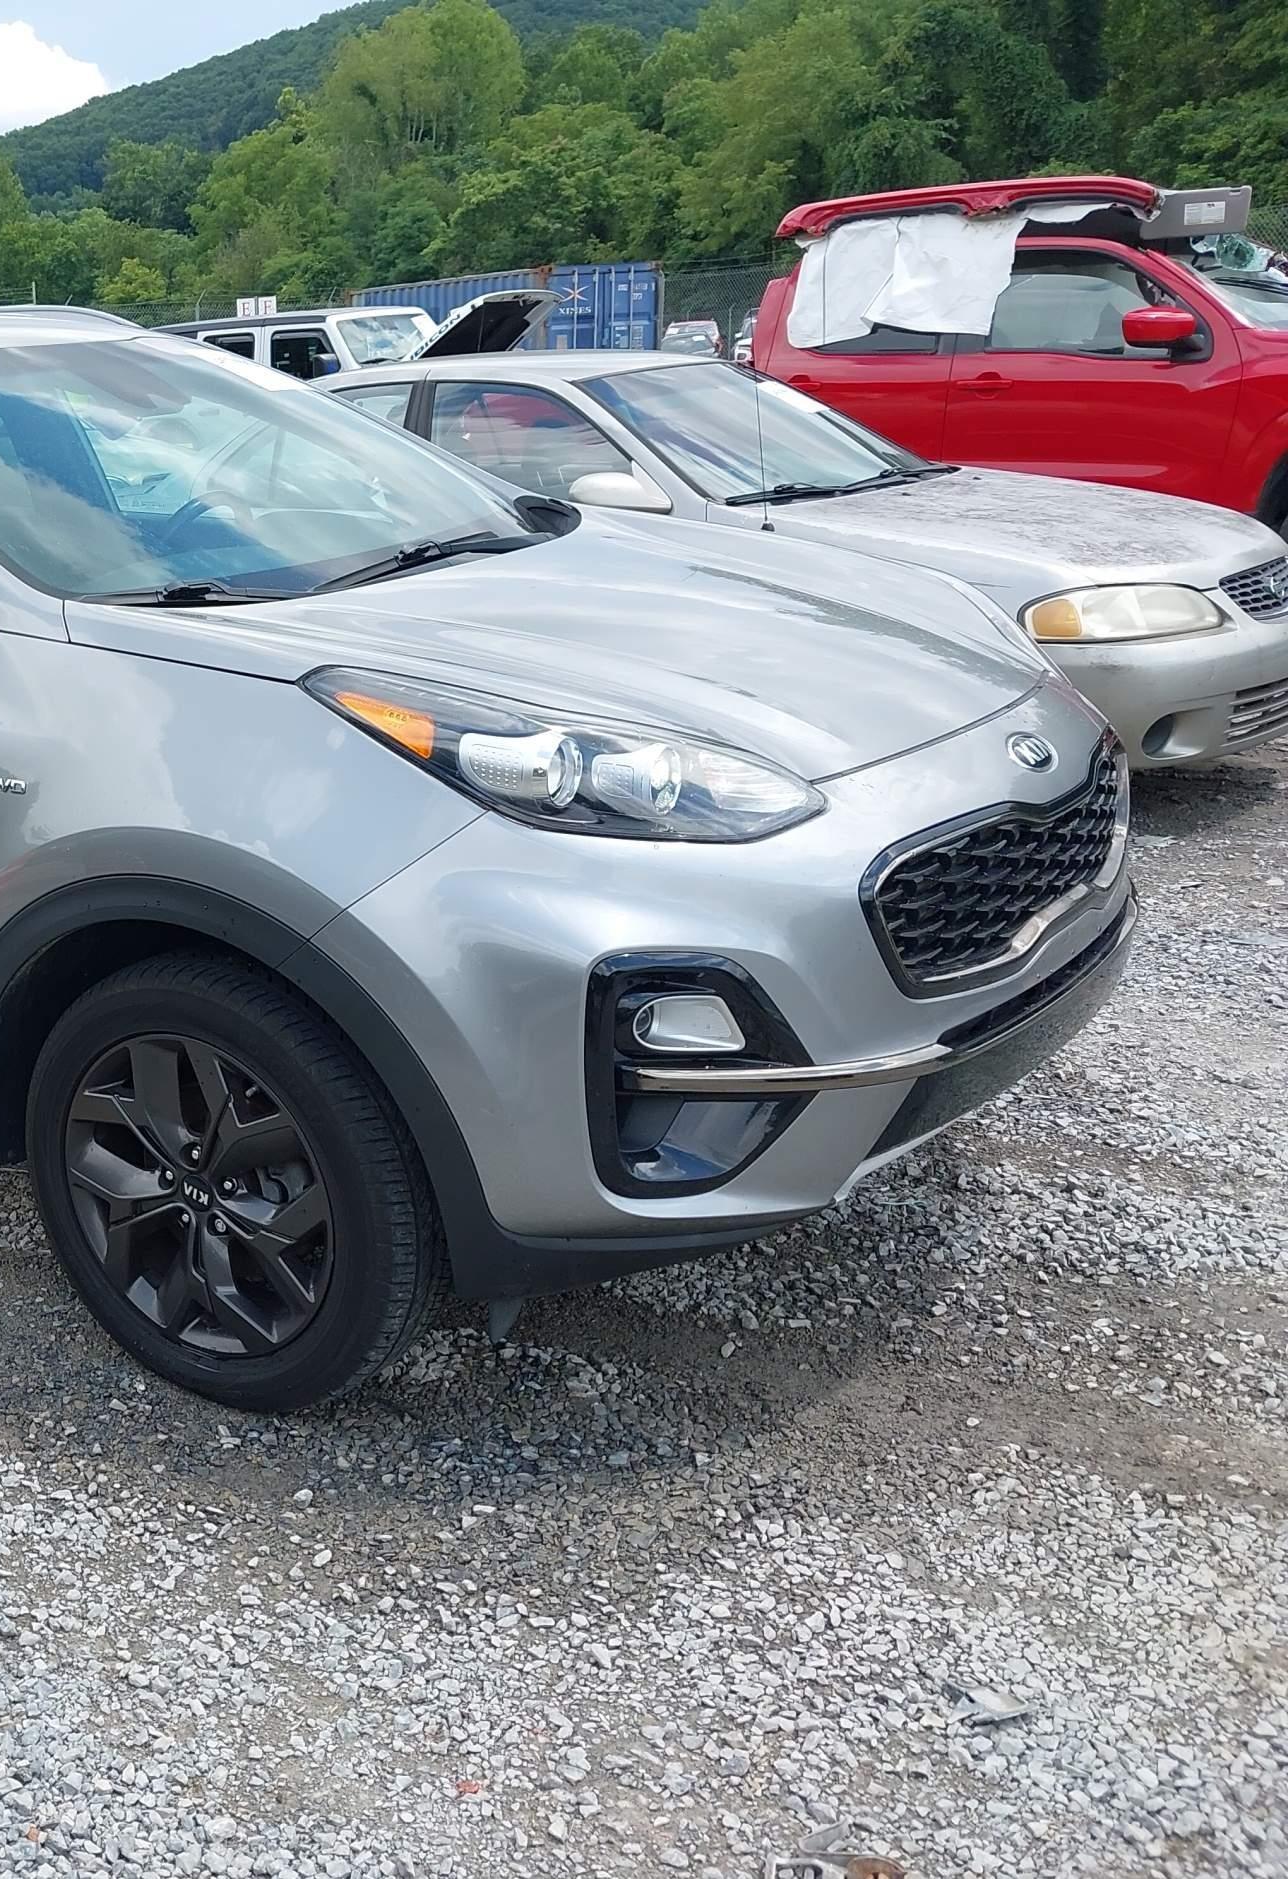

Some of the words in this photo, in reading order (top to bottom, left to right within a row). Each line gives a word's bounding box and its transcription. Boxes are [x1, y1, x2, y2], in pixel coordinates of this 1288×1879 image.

[242, 302, 251, 317] E
[263, 300, 272, 314] F
[183, 1180, 209, 1206] KIA
